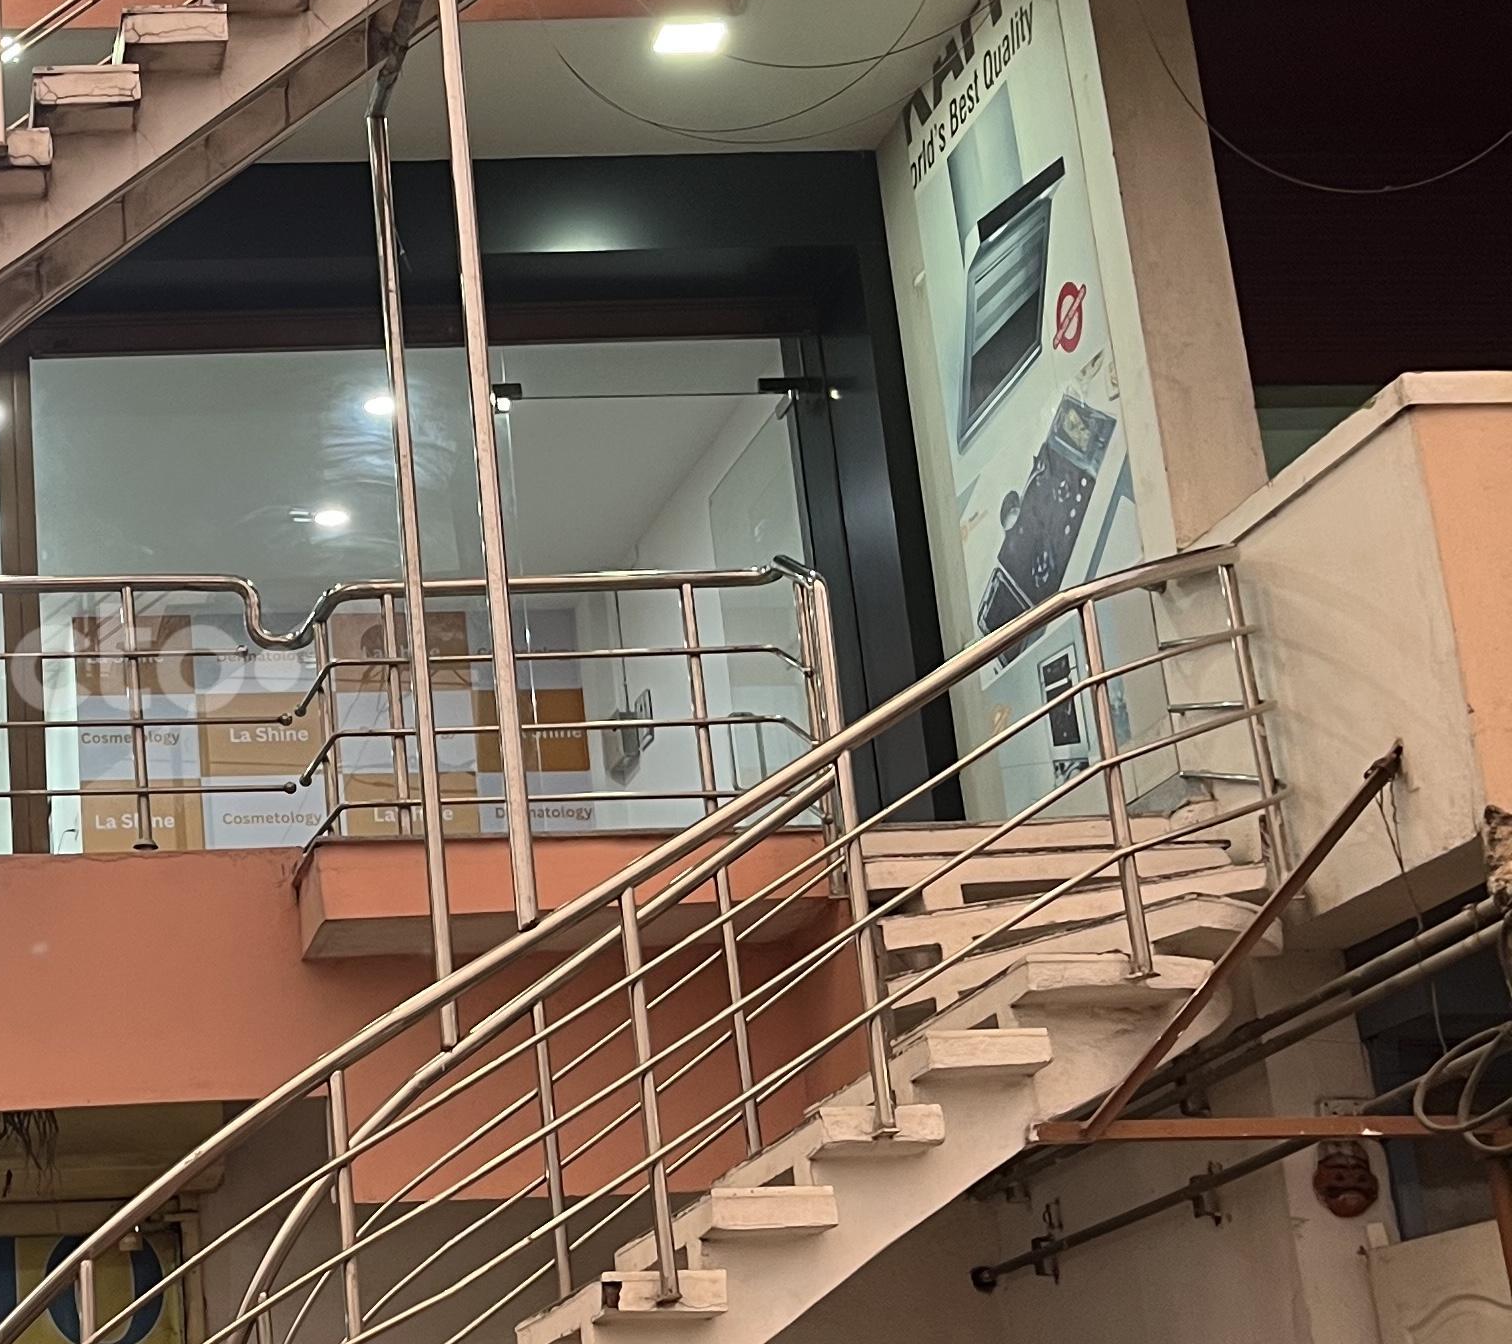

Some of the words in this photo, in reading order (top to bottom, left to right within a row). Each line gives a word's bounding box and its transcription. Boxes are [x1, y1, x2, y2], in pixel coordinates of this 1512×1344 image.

[949, 69, 981, 138] Best
[983, 0, 1034, 91] Quality
[81, 731, 180, 746] Cosmeology
[229, 727, 252, 743] La
[256, 726, 309, 742] Shine
[95, 814, 117, 830] La
[122, 813, 175, 829] Sne
[222, 811, 323, 827] Cosmetology
[373, 808, 395, 823] La
